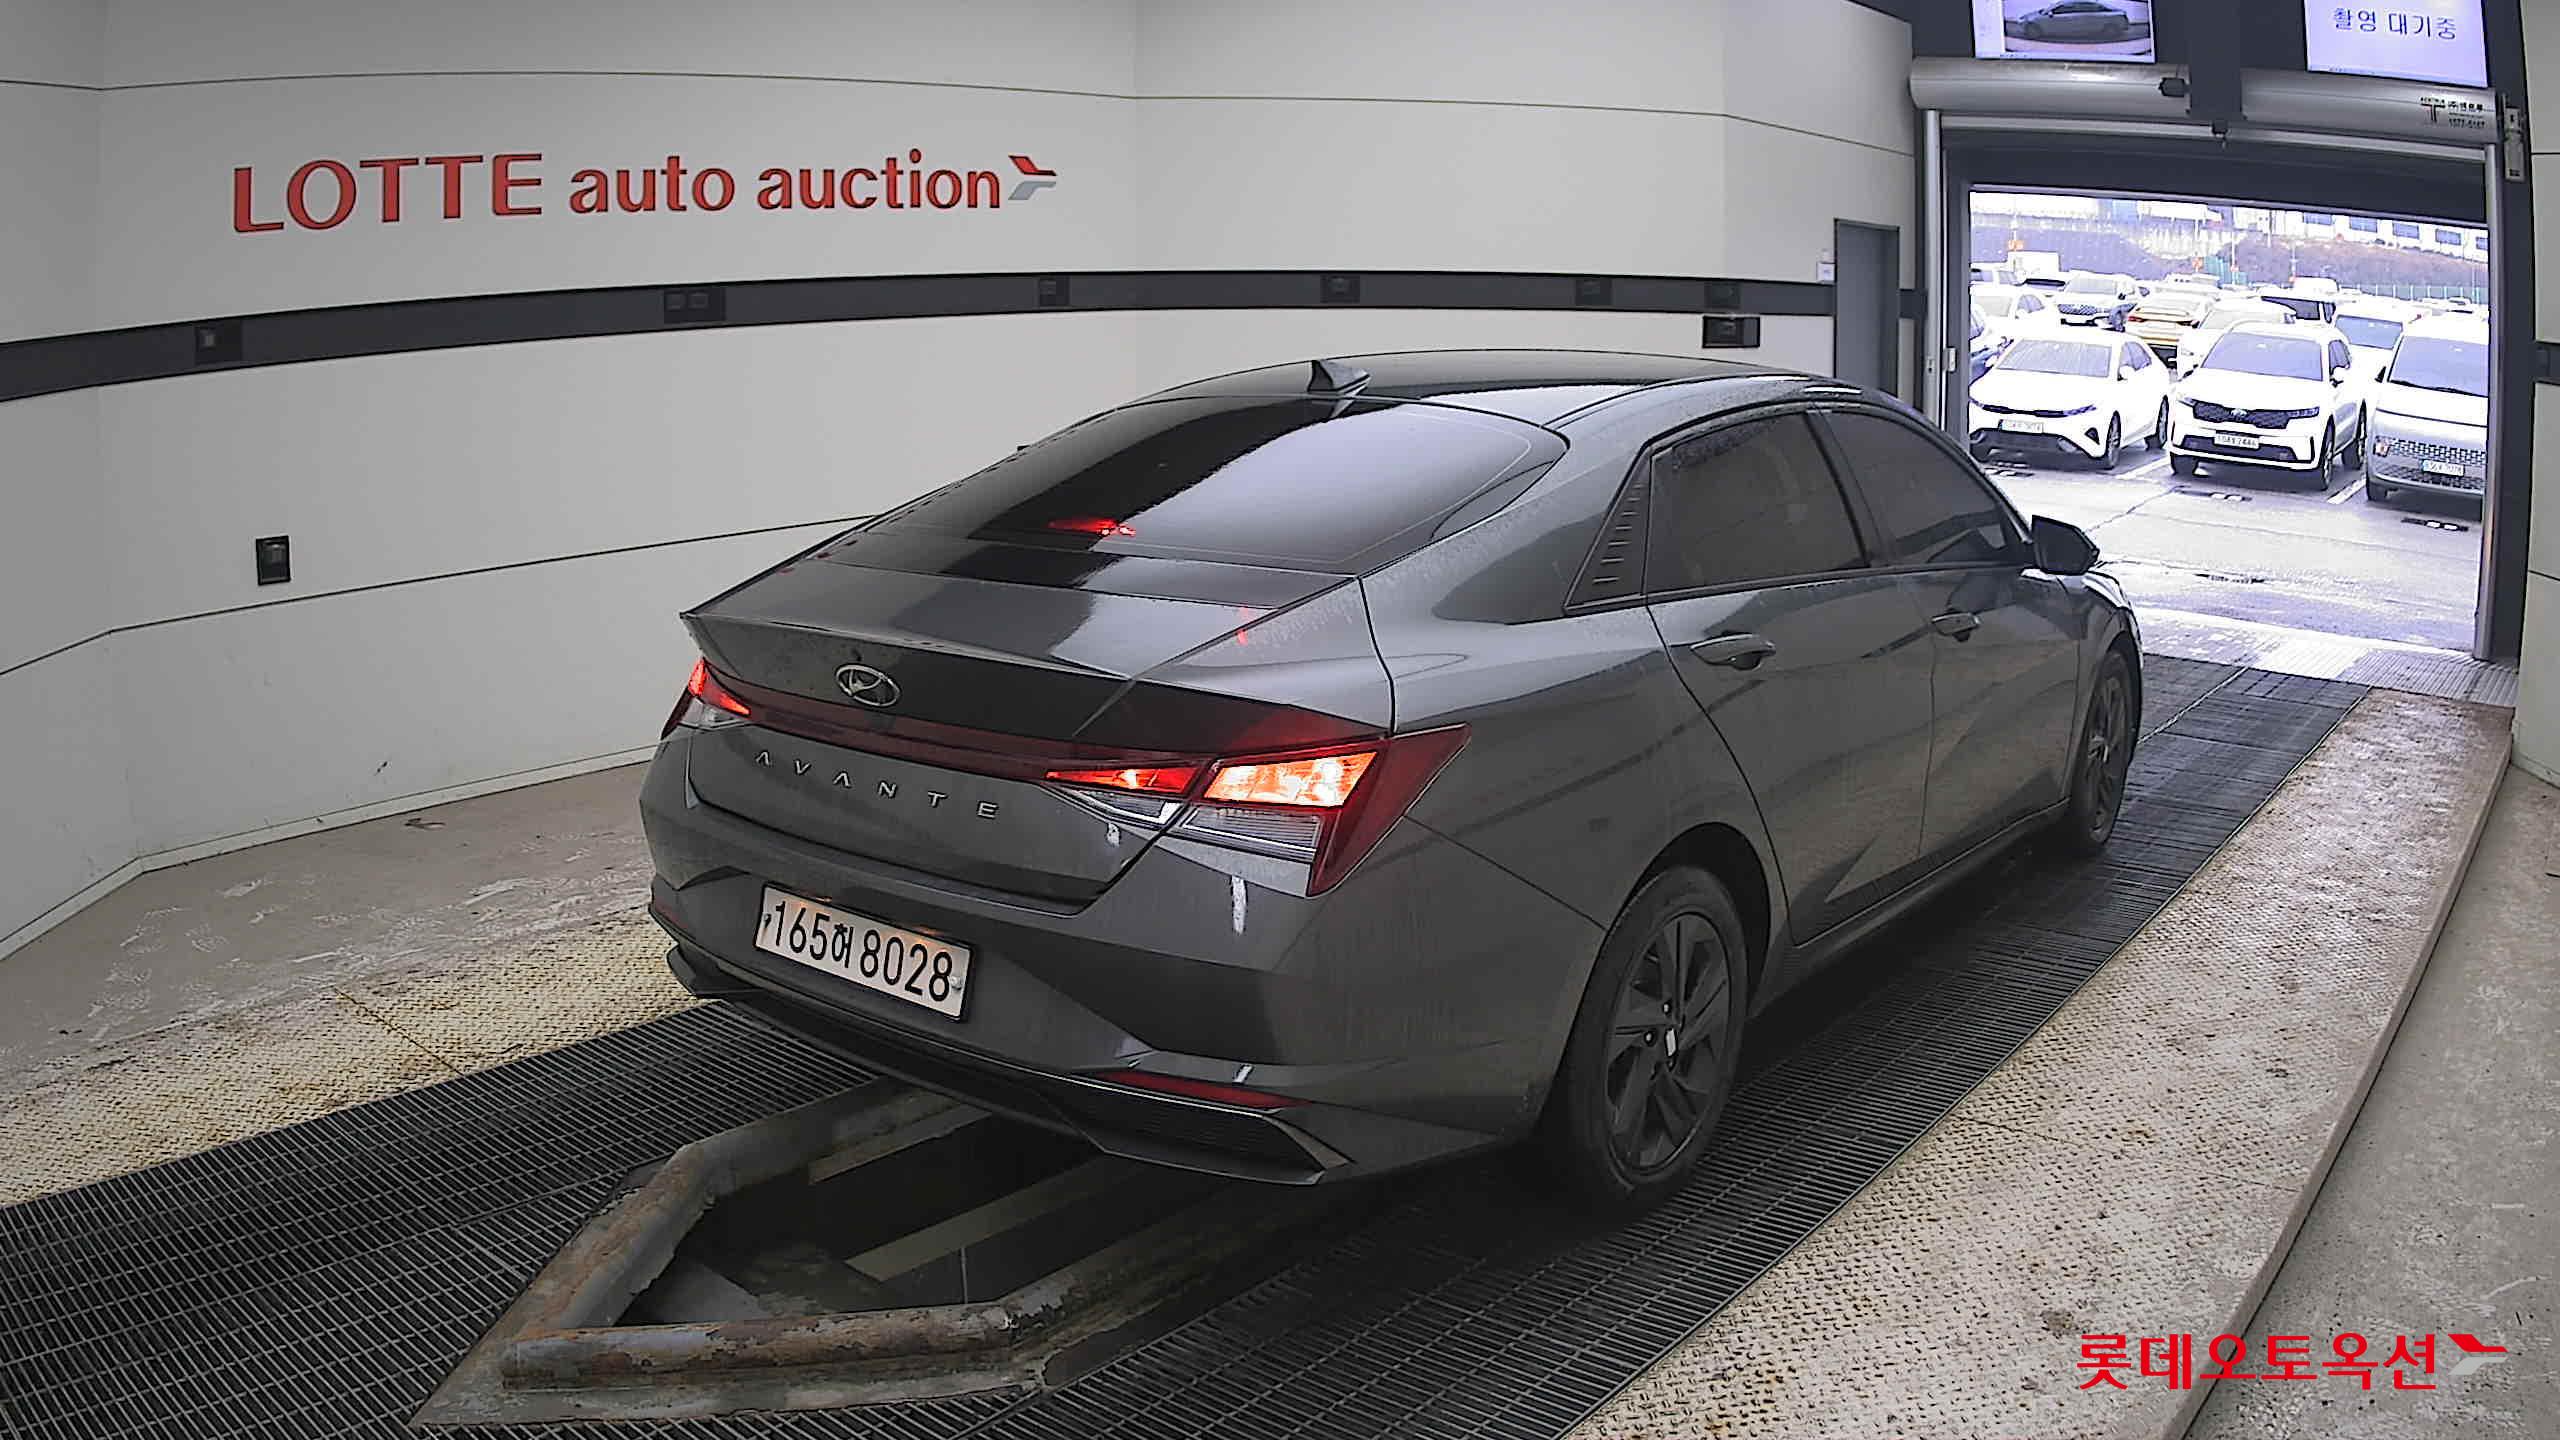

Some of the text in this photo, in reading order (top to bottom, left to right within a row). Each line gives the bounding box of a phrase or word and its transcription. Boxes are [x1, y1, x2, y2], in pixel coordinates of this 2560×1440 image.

[2334, 7, 2457, 41] 촬영 대기중
[233, 147, 1002, 234] LOTTE auto auction
[755, 750, 999, 820] AVANTE
